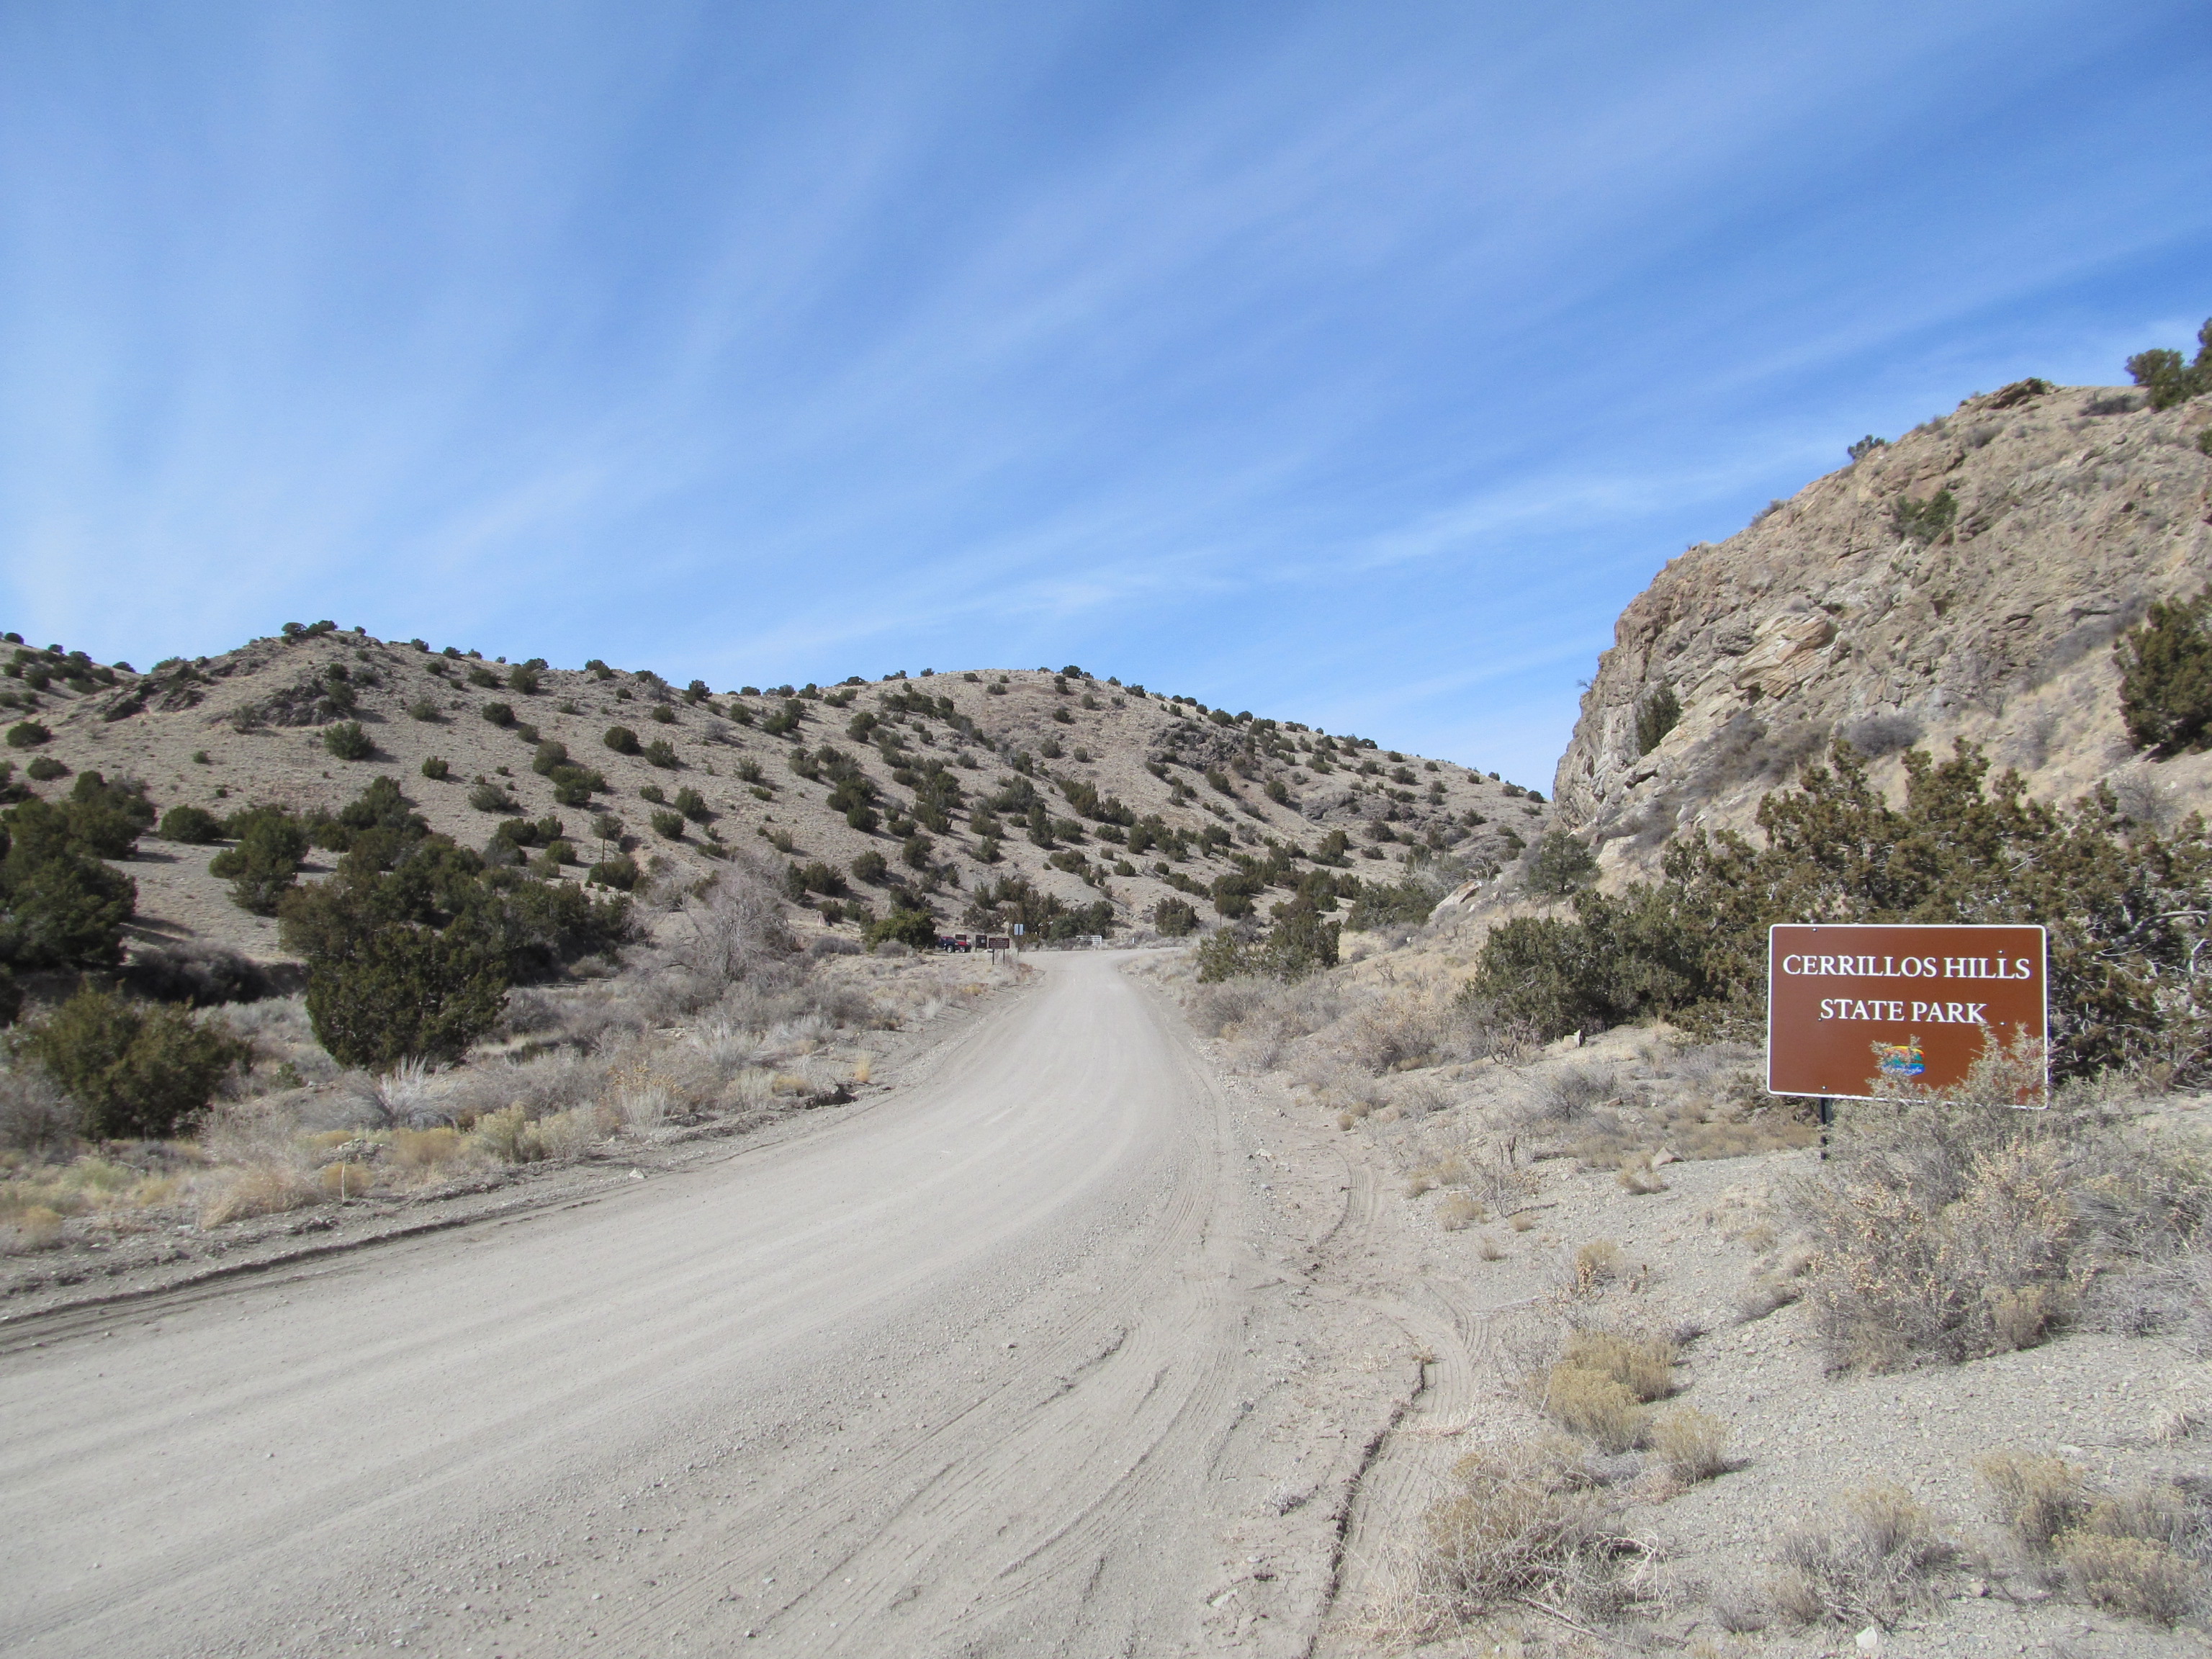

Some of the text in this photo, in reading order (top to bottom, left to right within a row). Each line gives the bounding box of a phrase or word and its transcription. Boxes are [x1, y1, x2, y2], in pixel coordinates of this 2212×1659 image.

[1783, 954, 2031, 980] CERRILLOS HILLS
[1820, 998, 1987, 1024] STATE PARK
